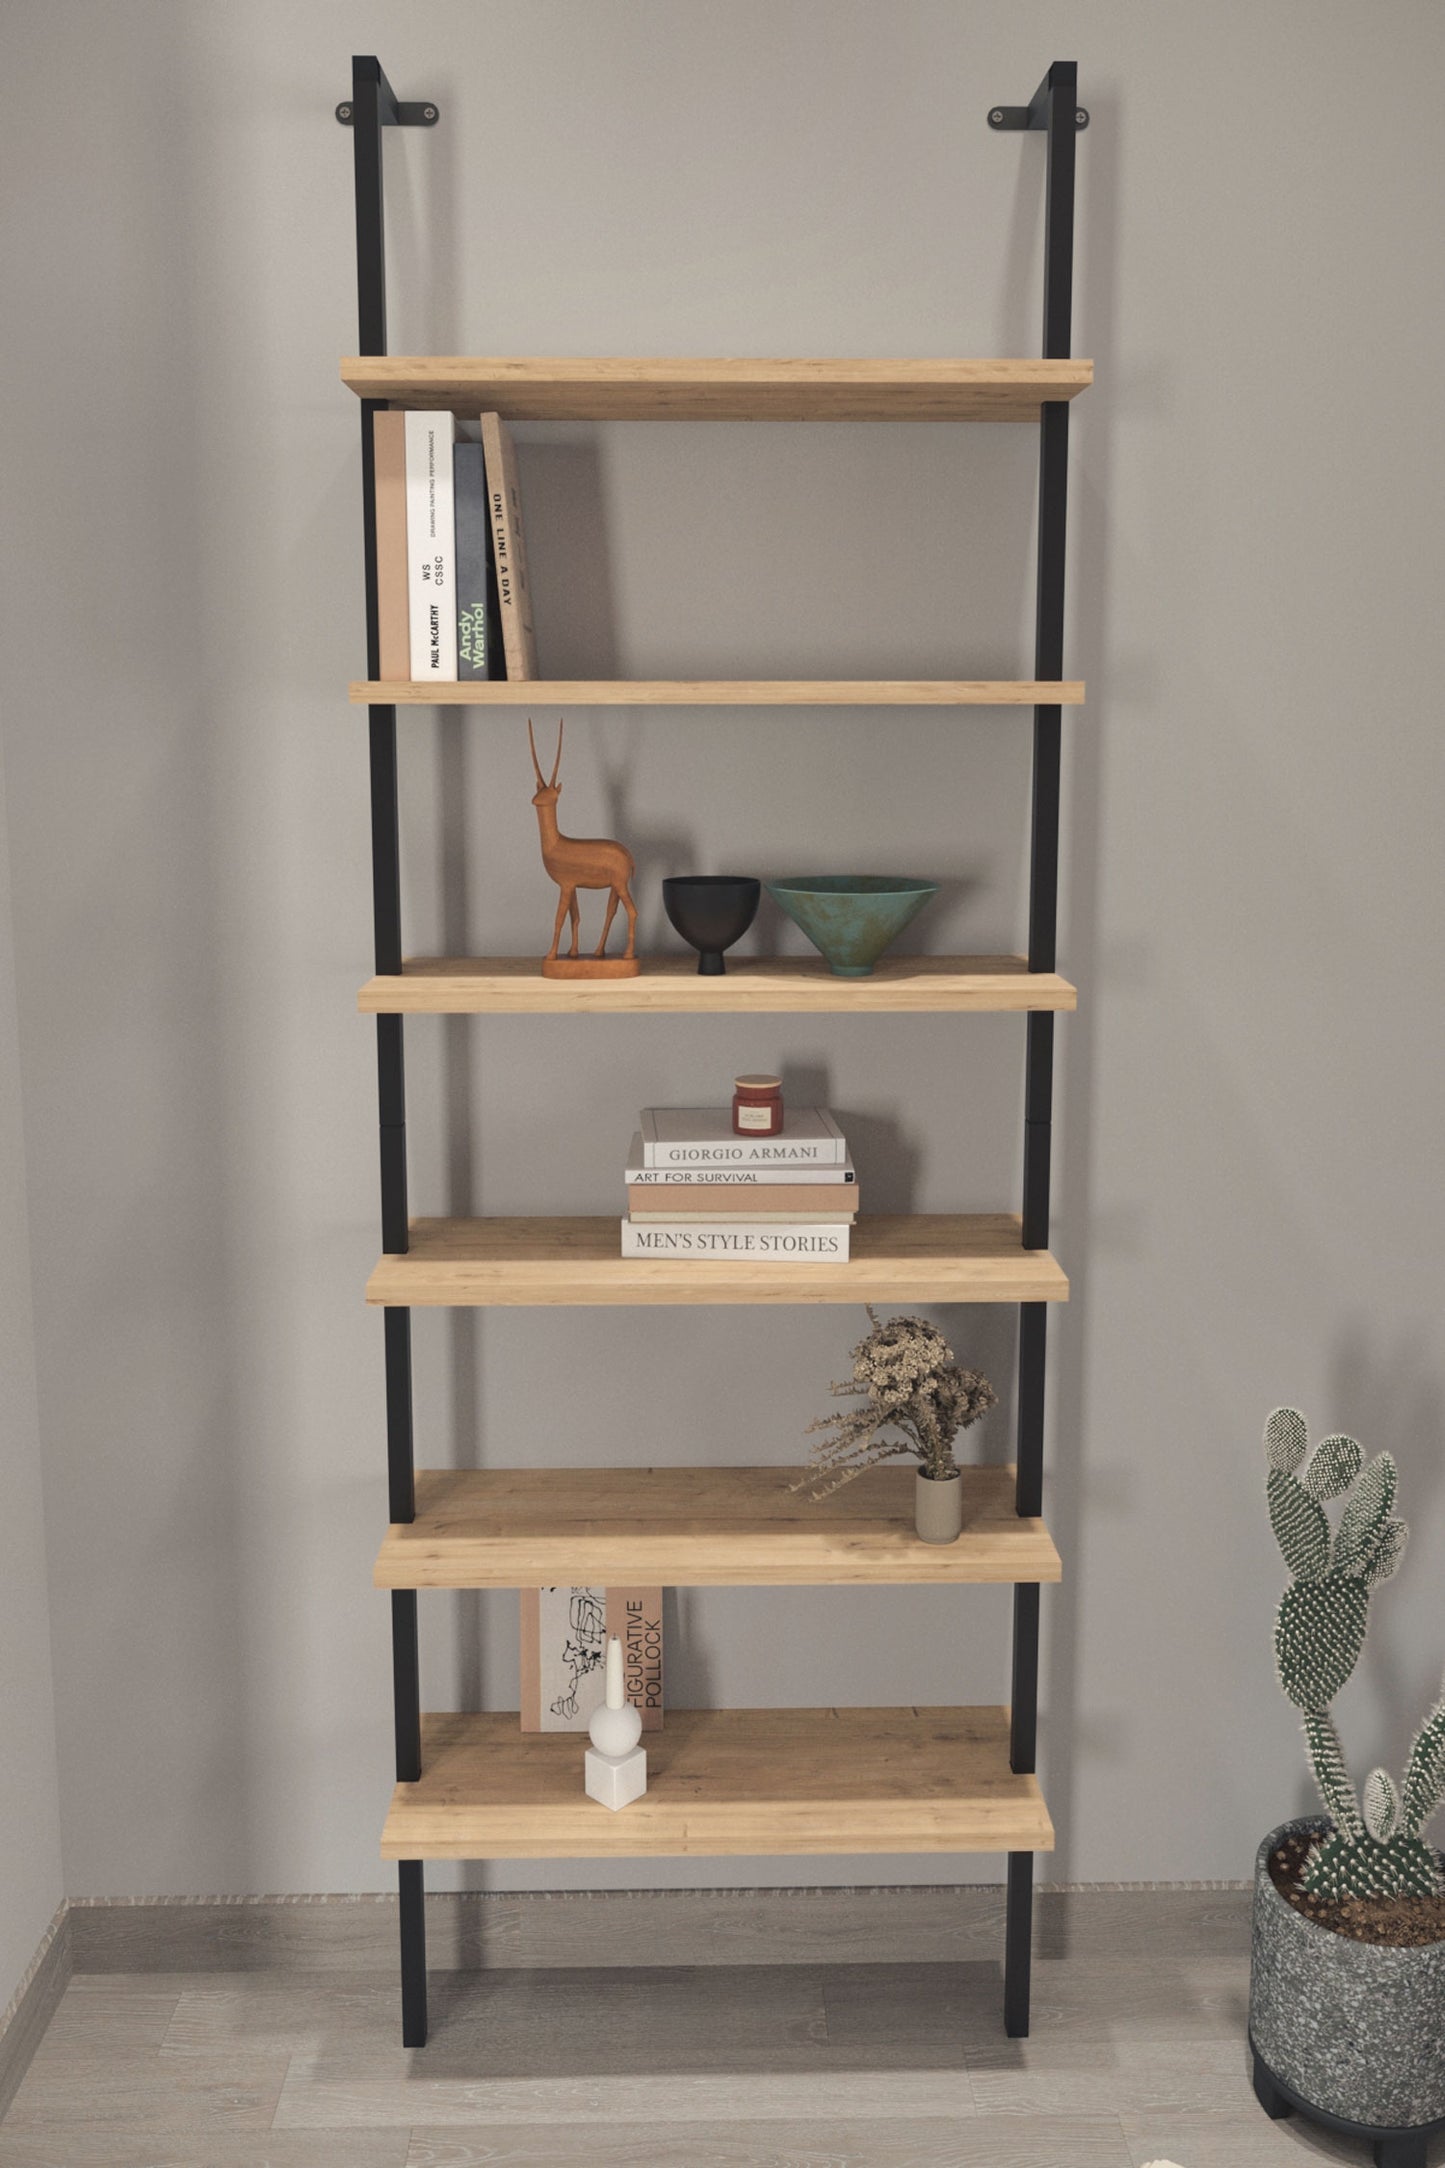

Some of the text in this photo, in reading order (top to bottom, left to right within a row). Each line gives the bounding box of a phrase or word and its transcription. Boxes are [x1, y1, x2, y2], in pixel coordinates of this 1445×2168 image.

[493, 494, 502, 521] ONE
[496, 528, 507, 559] LINE
[422, 564, 430, 580] WS
[434, 556, 444, 586] CSSC
[502, 579, 512, 606] DAY
[430, 604, 440, 668] PAUL McCARTHY
[458, 610, 474, 661] Andy
[471, 602, 485, 670] Warhol
[669, 1146, 818, 1161] GIORGIO ARMANI
[634, 1172, 758, 1182] ART FOR SURVIVAL
[636, 1232, 838, 1252] MEN'S STYLE STORIES
[626, 1600, 644, 1708] FIGURATIVE
[644, 1620, 662, 1708] POLLOCK
